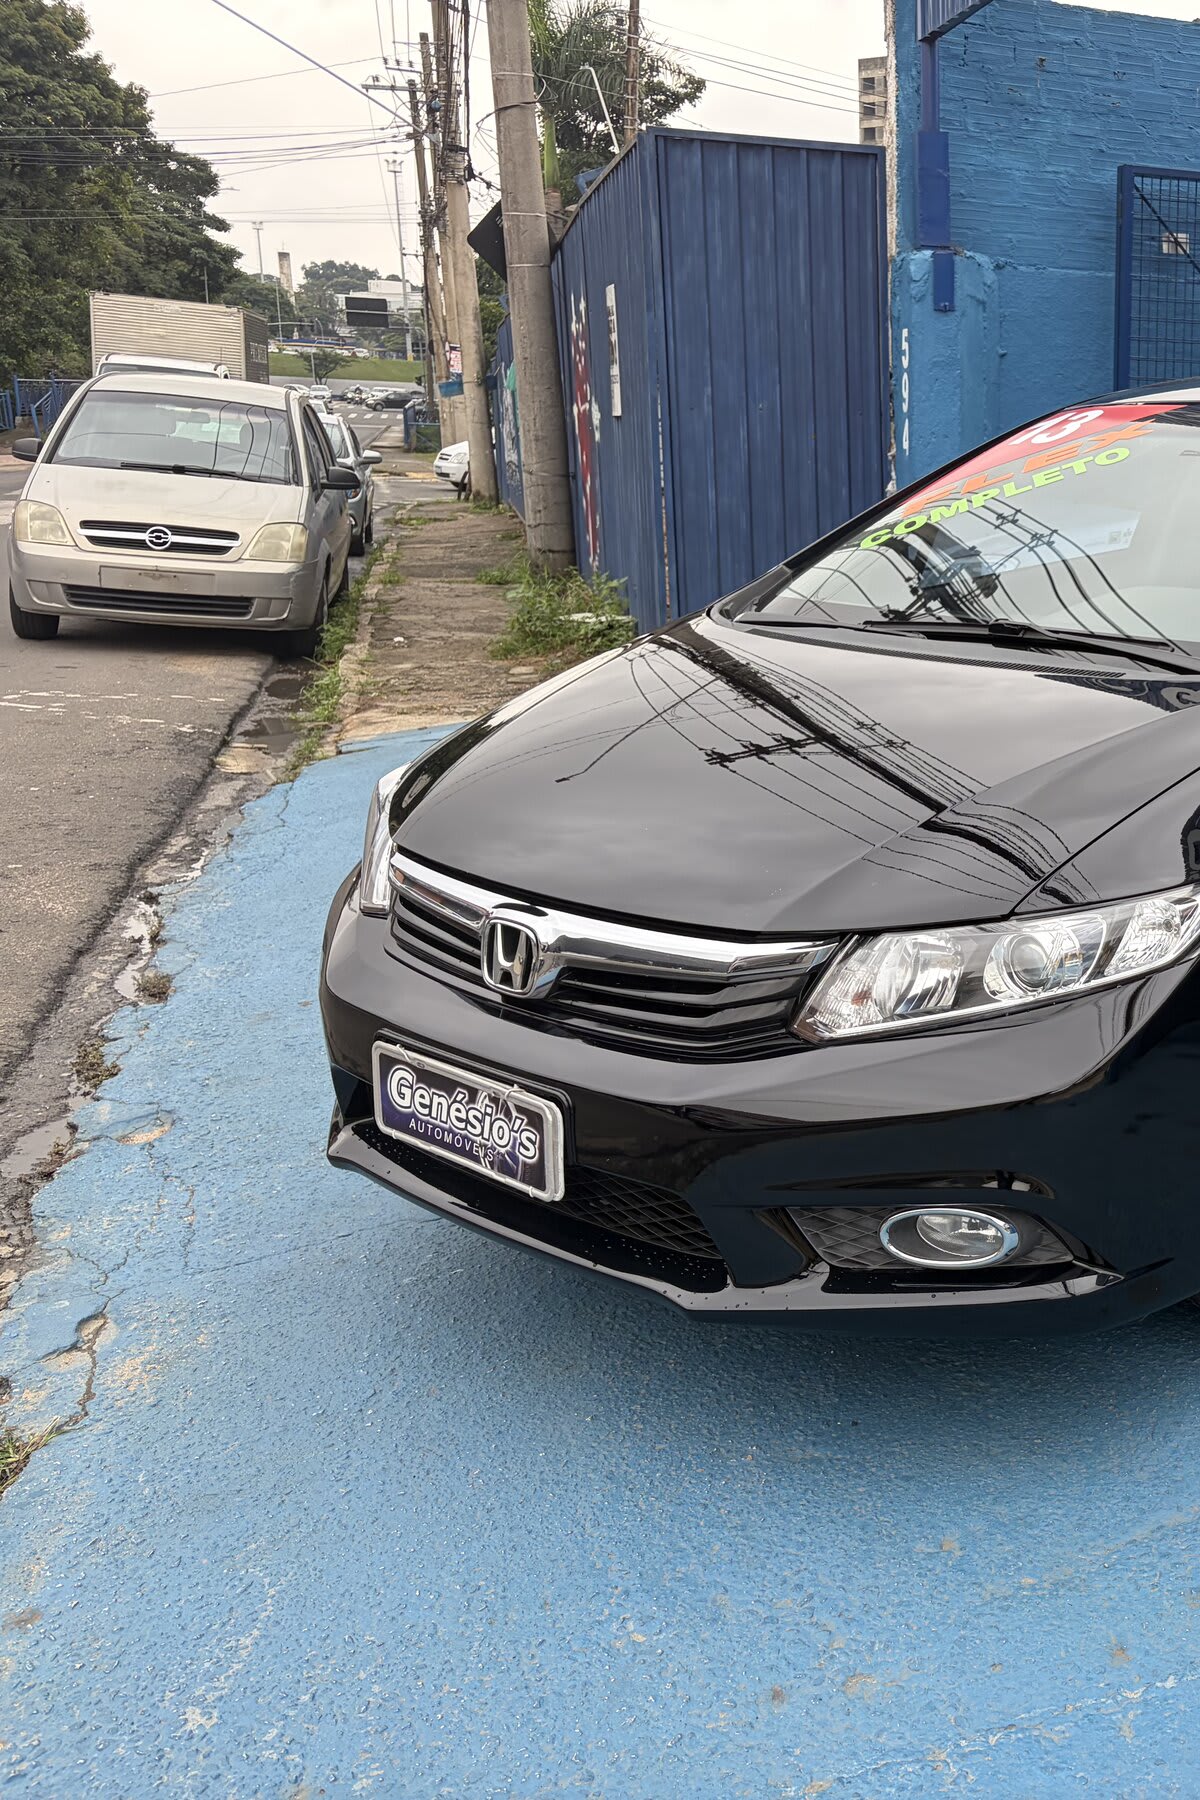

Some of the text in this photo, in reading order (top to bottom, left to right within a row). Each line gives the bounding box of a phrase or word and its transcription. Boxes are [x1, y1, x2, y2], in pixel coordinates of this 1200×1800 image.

[901, 328, 909, 456] 594
[1008, 409, 1104, 445] 13
[860, 448, 1131, 549] COMPLETO
[901, 418, 1156, 518] FLEX
[388, 1066, 539, 1161] Genésio's
[409, 1118, 494, 1162] AUTOMÓVEIS
